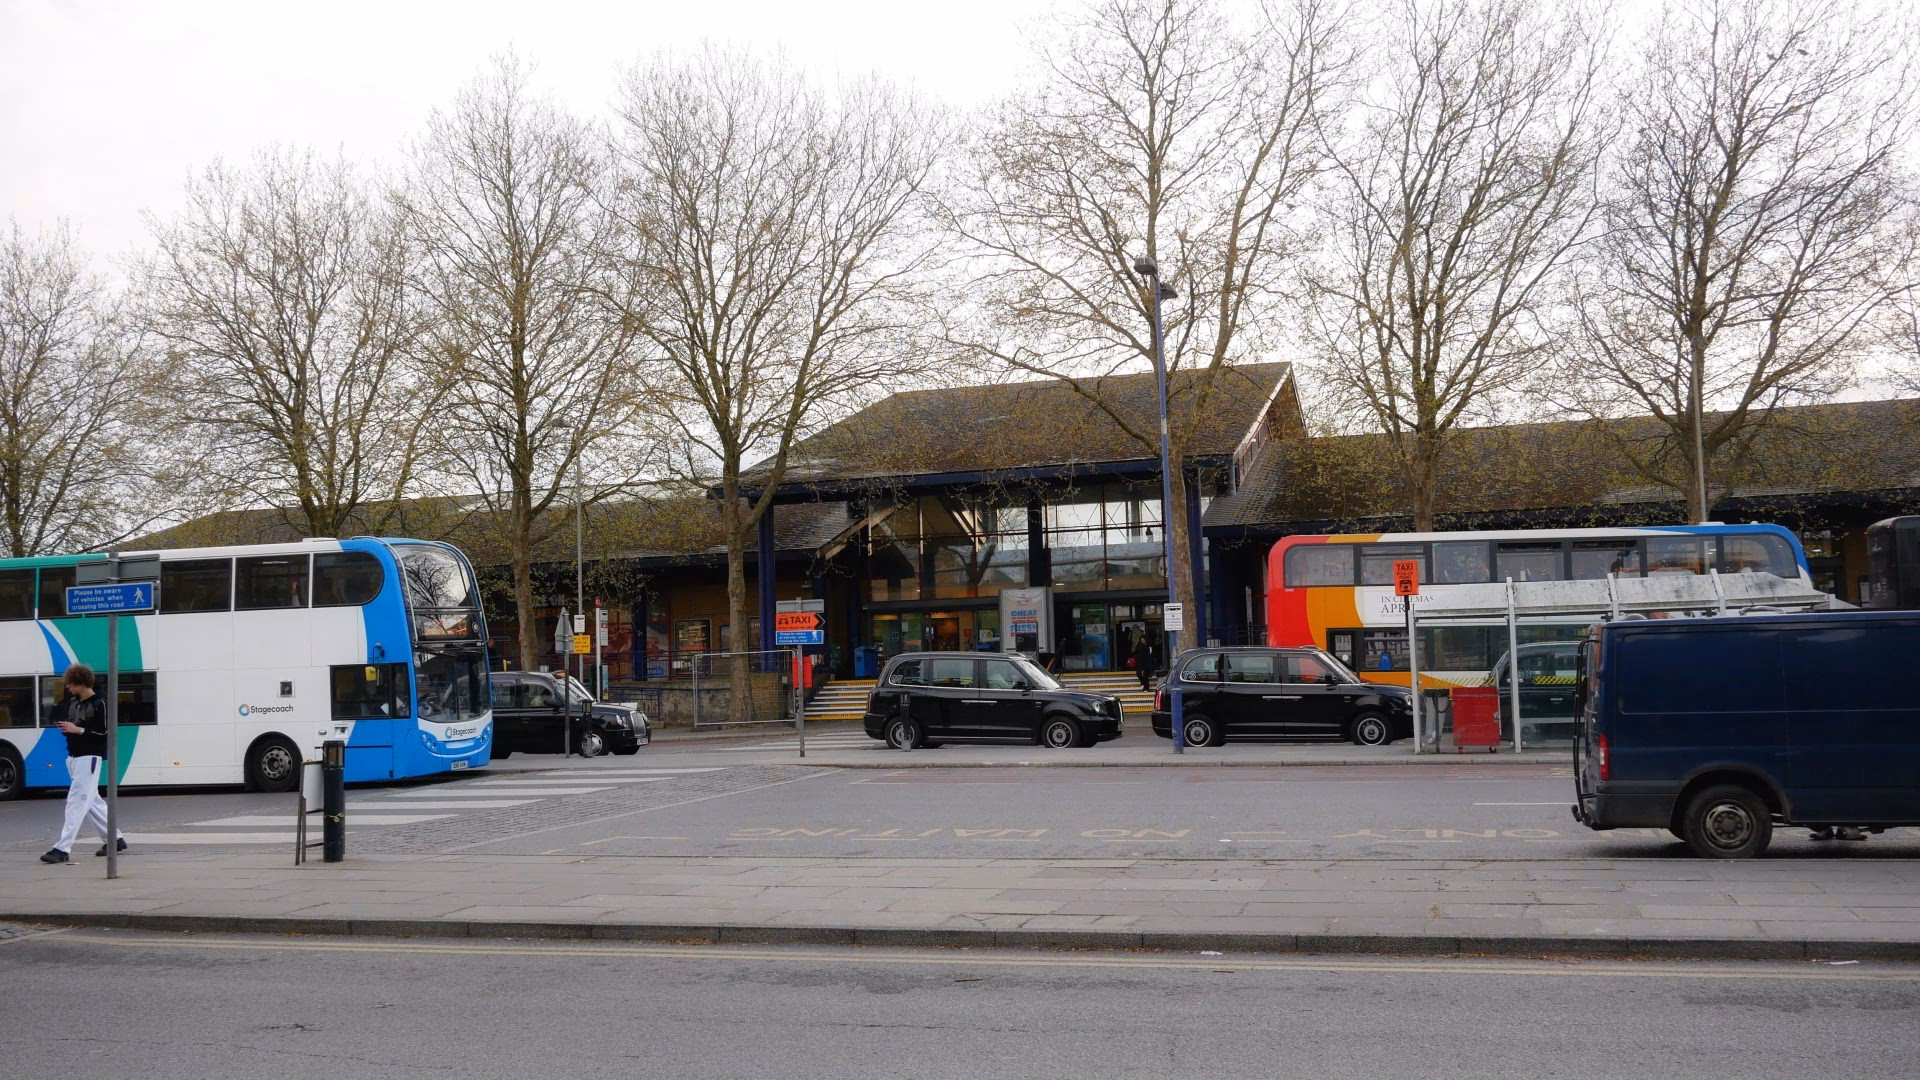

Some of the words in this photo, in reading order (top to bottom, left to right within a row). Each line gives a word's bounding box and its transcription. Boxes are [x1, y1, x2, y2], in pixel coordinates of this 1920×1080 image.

[1396, 563, 1413, 571] TAXI
[790, 616, 811, 624] TAXI
[250, 705, 294, 715] Stagecoach
[452, 727, 477, 737] Stagecoach
[727, 828, 1049, 838] WAITING
[1080, 828, 1192, 838] NO
[1333, 828, 1559, 839] ONLY
